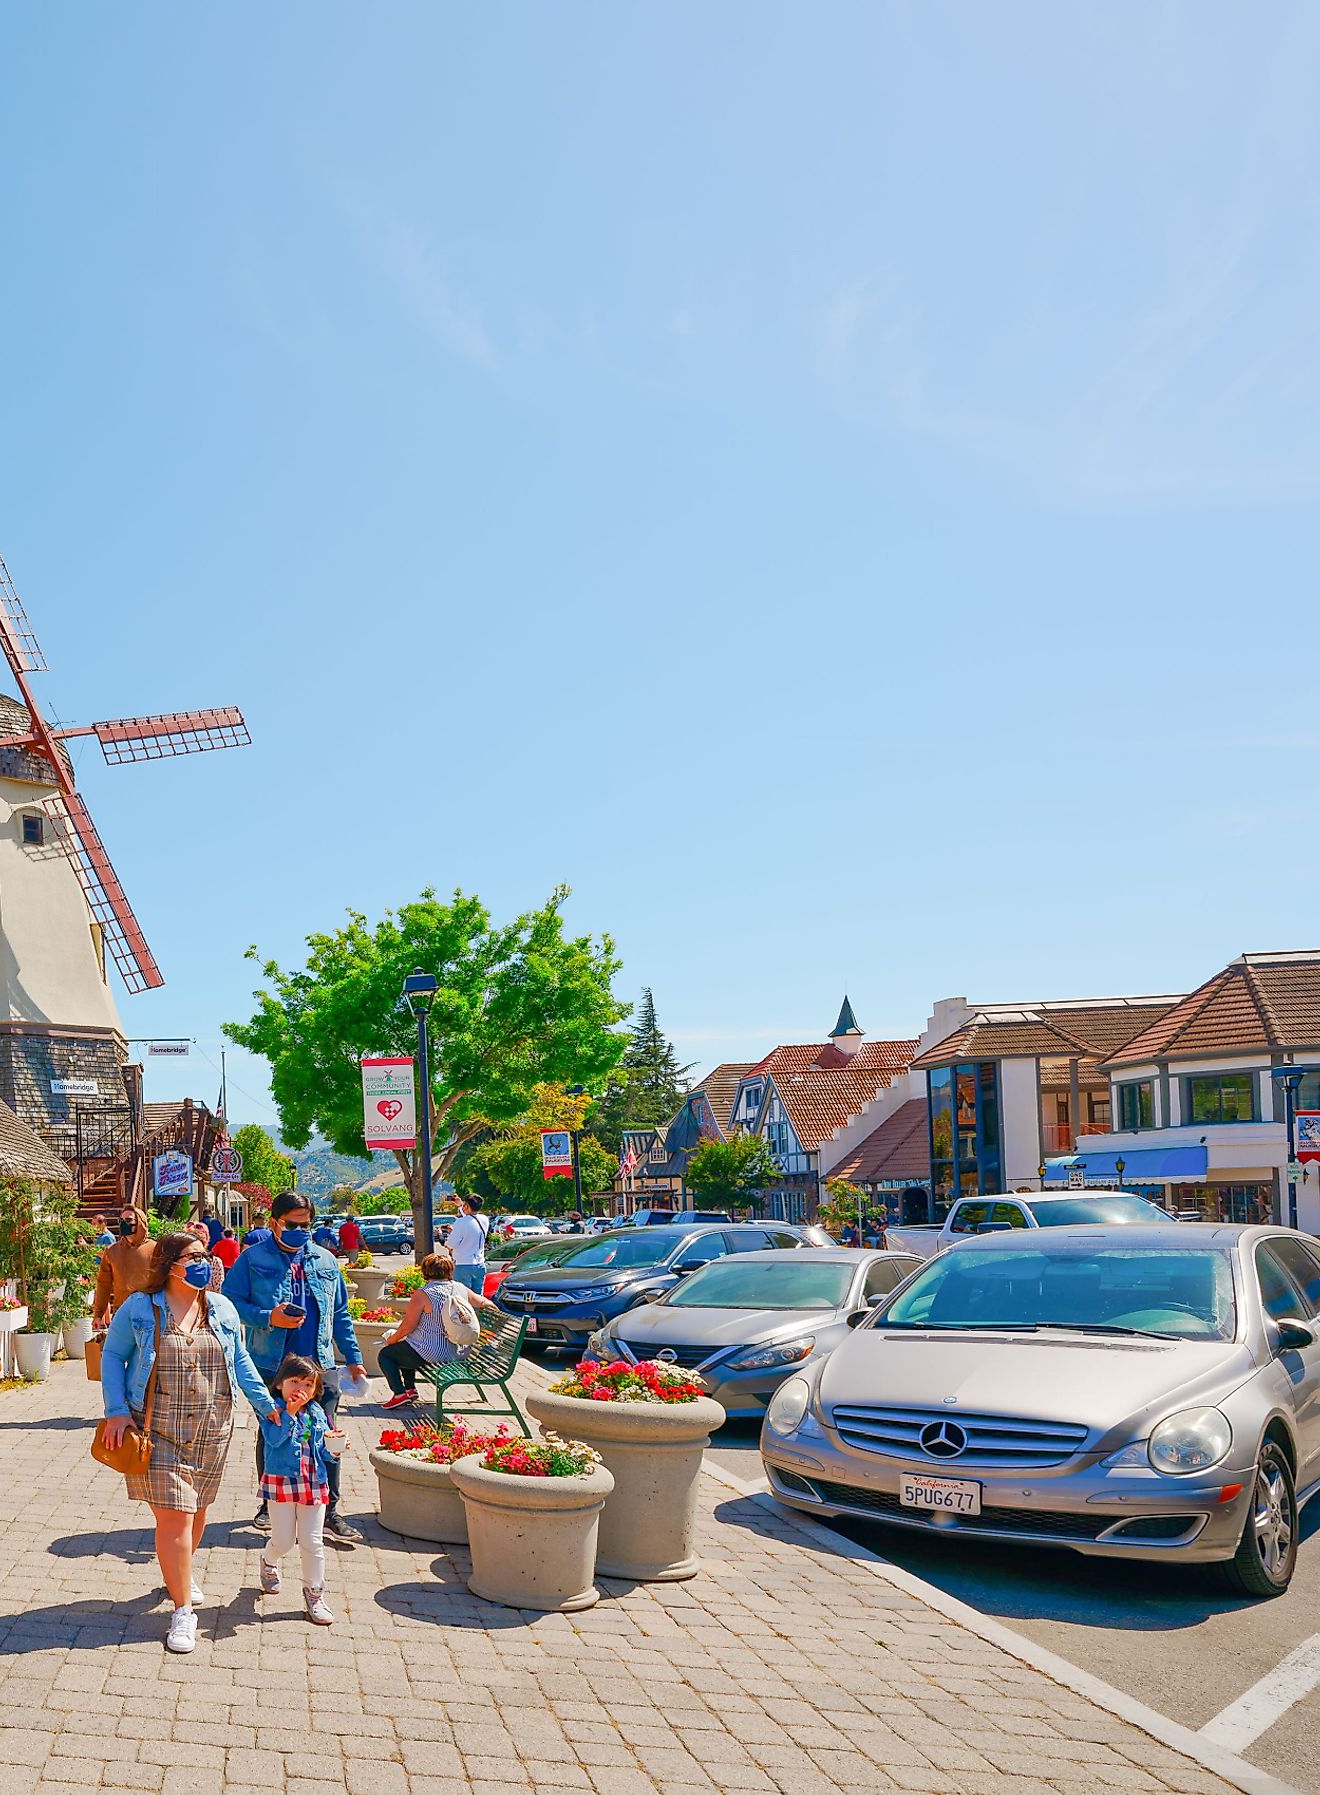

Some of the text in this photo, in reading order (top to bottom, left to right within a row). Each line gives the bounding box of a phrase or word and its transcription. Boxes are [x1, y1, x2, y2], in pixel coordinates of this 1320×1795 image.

[365, 1082, 411, 1090] COMMUNITY
[367, 1124, 413, 1133] SOLVANG
[915, 1478, 959, 1489] California
[905, 1485, 974, 1510] 5PUG677
